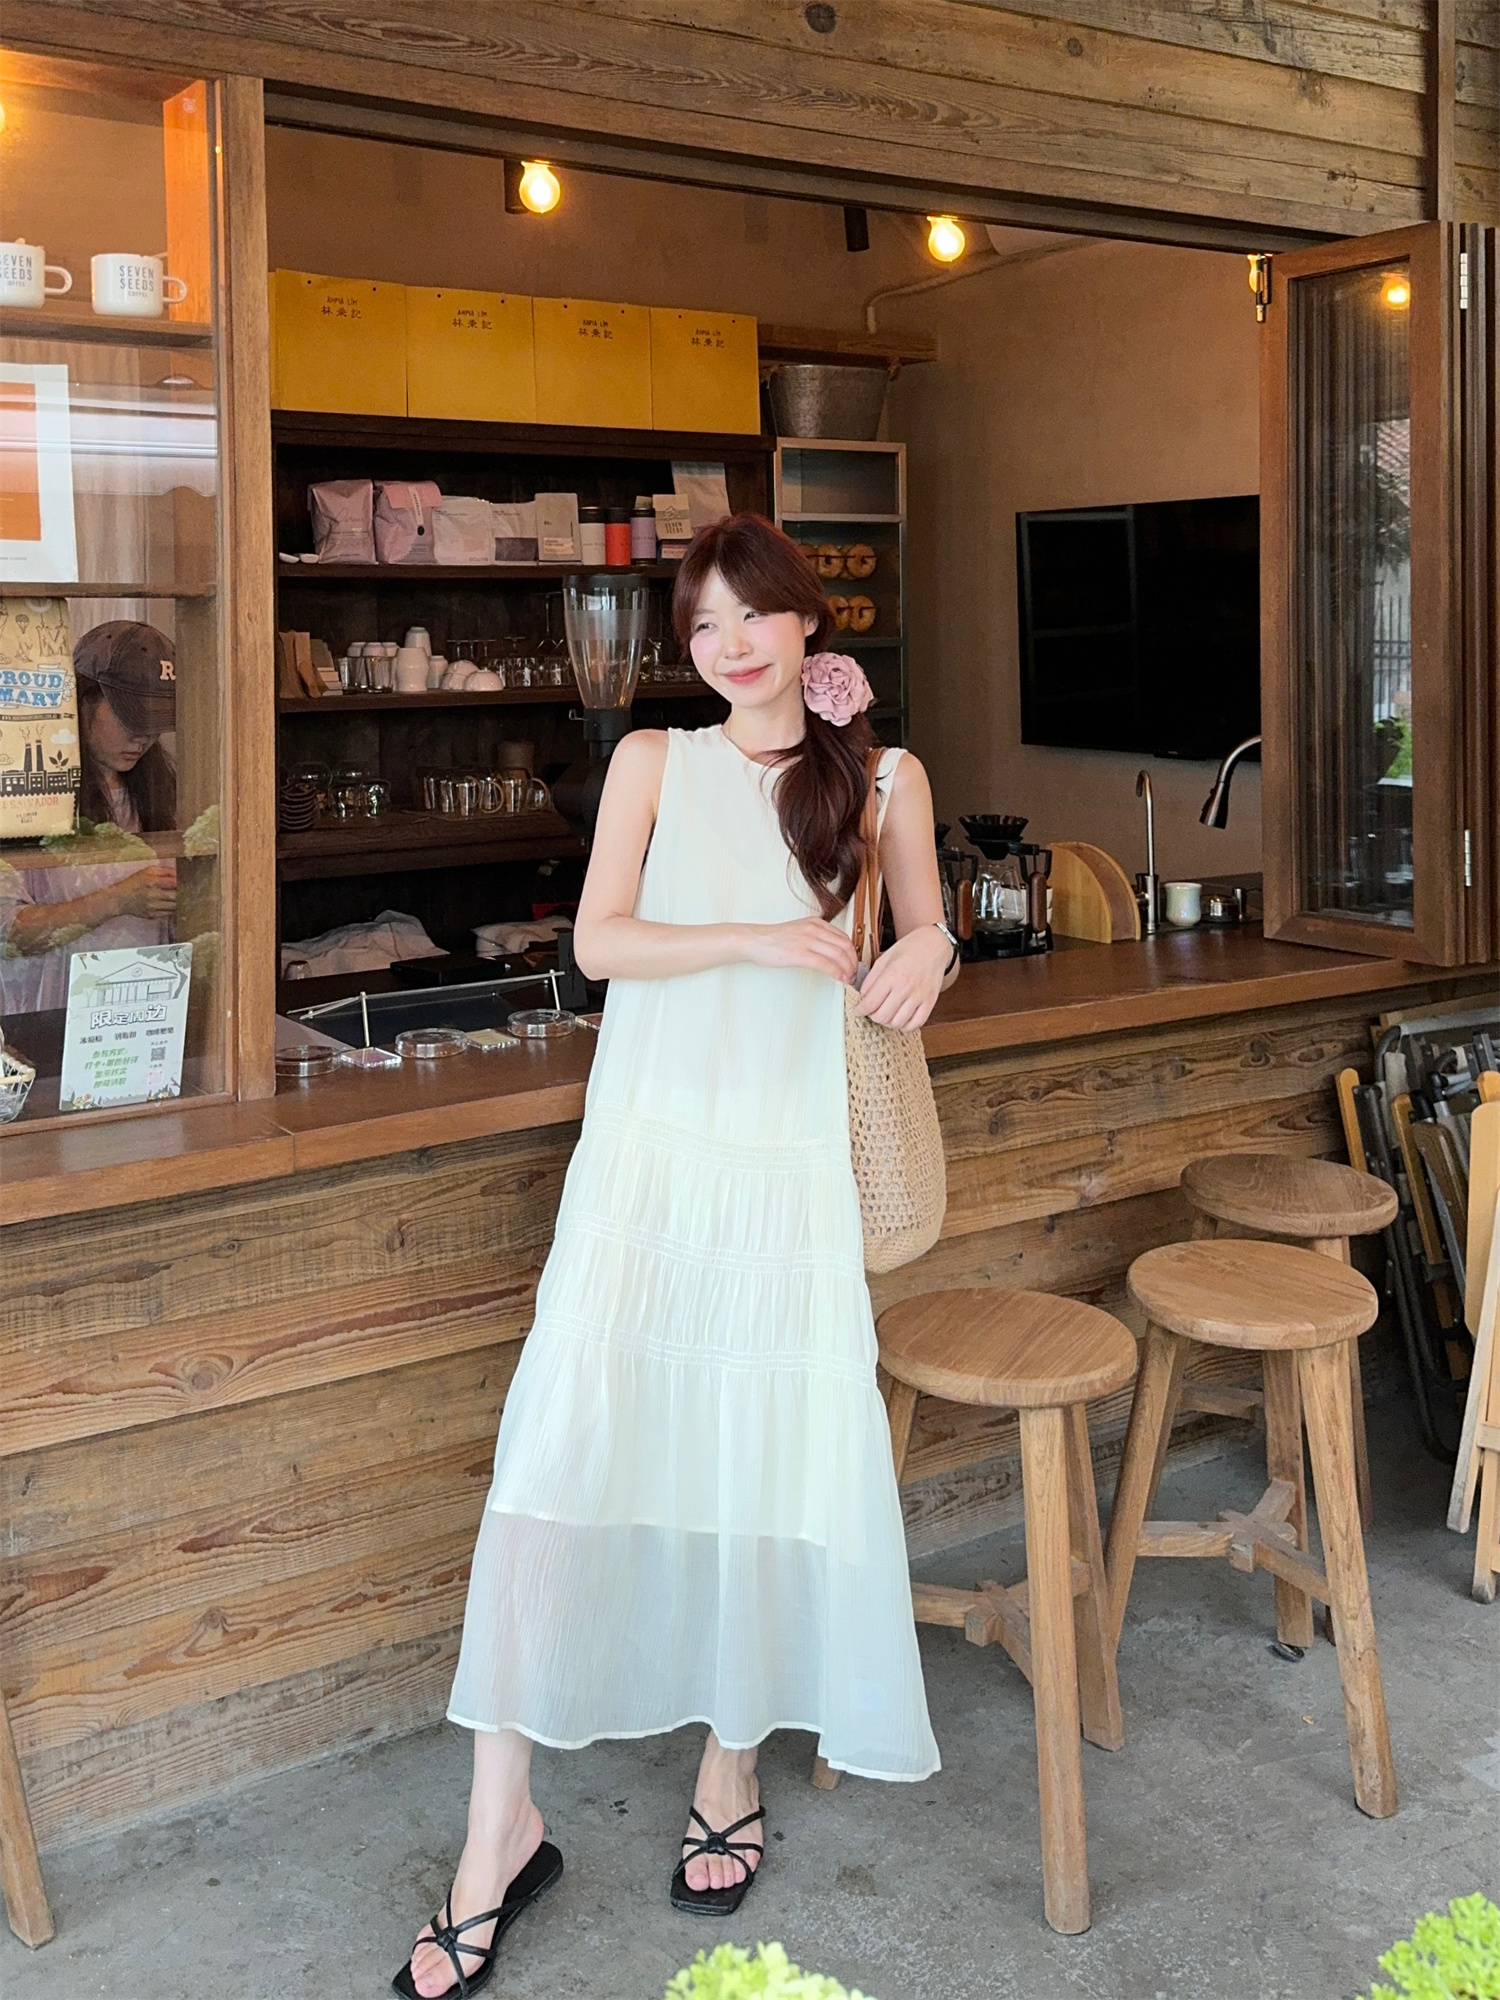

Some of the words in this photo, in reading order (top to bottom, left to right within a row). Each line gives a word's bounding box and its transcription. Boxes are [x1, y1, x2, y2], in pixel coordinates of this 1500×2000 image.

[119, 265, 154, 279] SEVEN
[119, 277, 154, 292] SEEDS
[128, 290, 148, 298] COFFEE
[0, 670, 63, 688] ROUD
[160, 660, 176, 680] R
[0, 687, 61, 707] MARY
[90, 1003, 168, 1030] 限定周边
